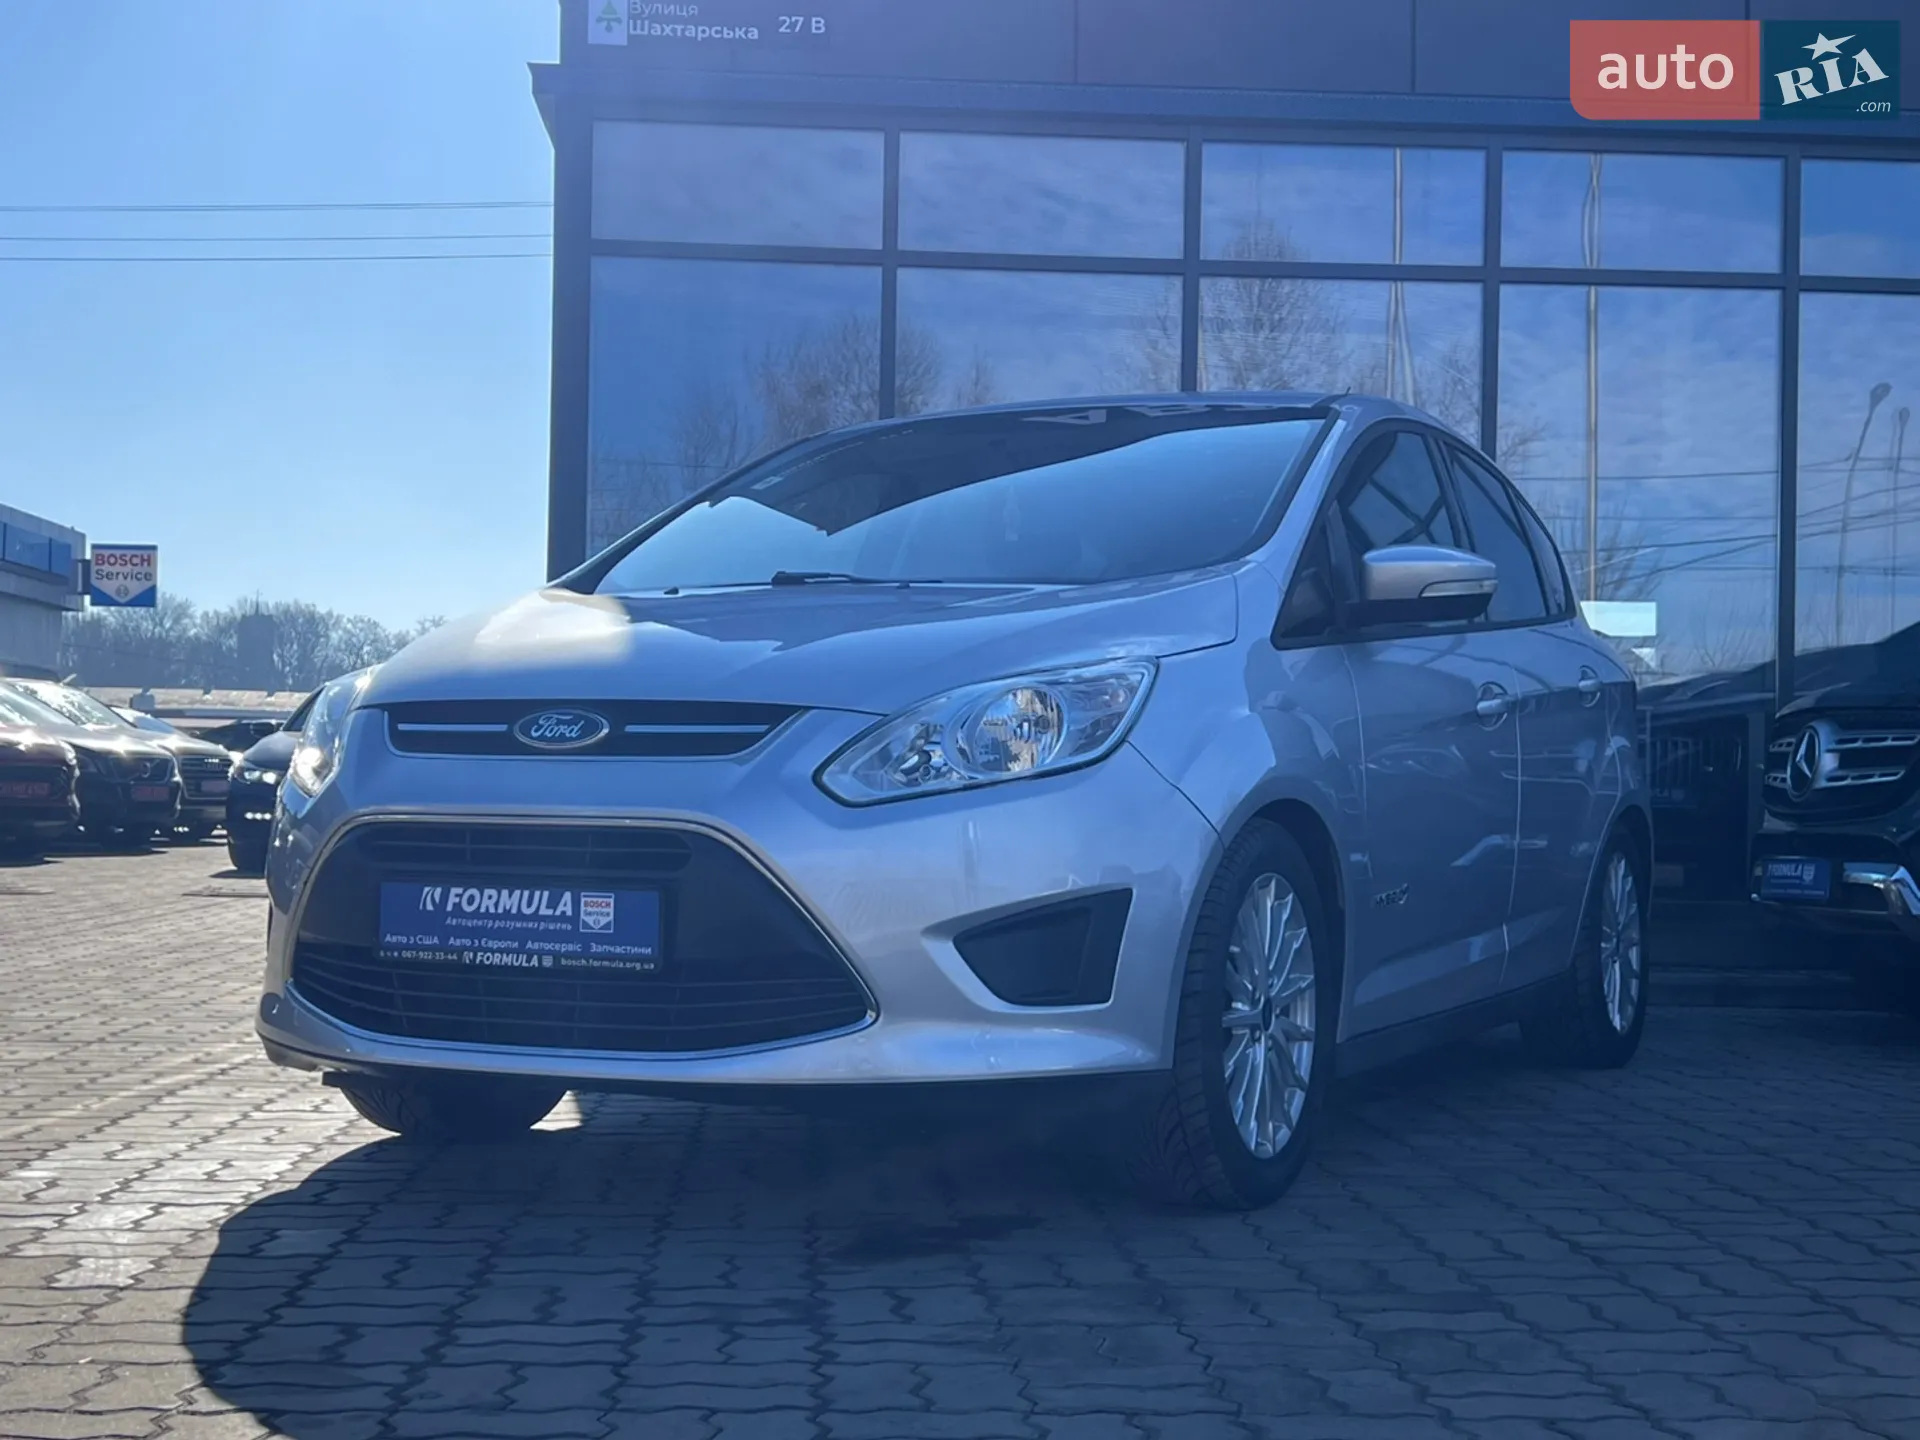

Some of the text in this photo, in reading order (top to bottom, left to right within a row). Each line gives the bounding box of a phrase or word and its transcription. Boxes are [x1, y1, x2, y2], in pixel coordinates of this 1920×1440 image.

[629, 0, 698, 17] Вулиця
[629, 19, 759, 40] Шахтарська
[778, 16, 804, 33] 27
[95, 553, 151, 567] BOSCH
[95, 568, 153, 581] Service
[530, 713, 585, 738] Ford
[446, 886, 573, 916] FORMULA
[583, 900, 611, 909] BOSCH
[583, 909, 611, 918] Service
[384, 933, 407, 944] Авто
[416, 934, 439, 945] США
[448, 936, 472, 947] Авто
[481, 938, 519, 949] Європи
[526, 940, 582, 953] Автосервіс
[589, 942, 652, 955] Запчастини
[475, 952, 539, 967] FORMULA
